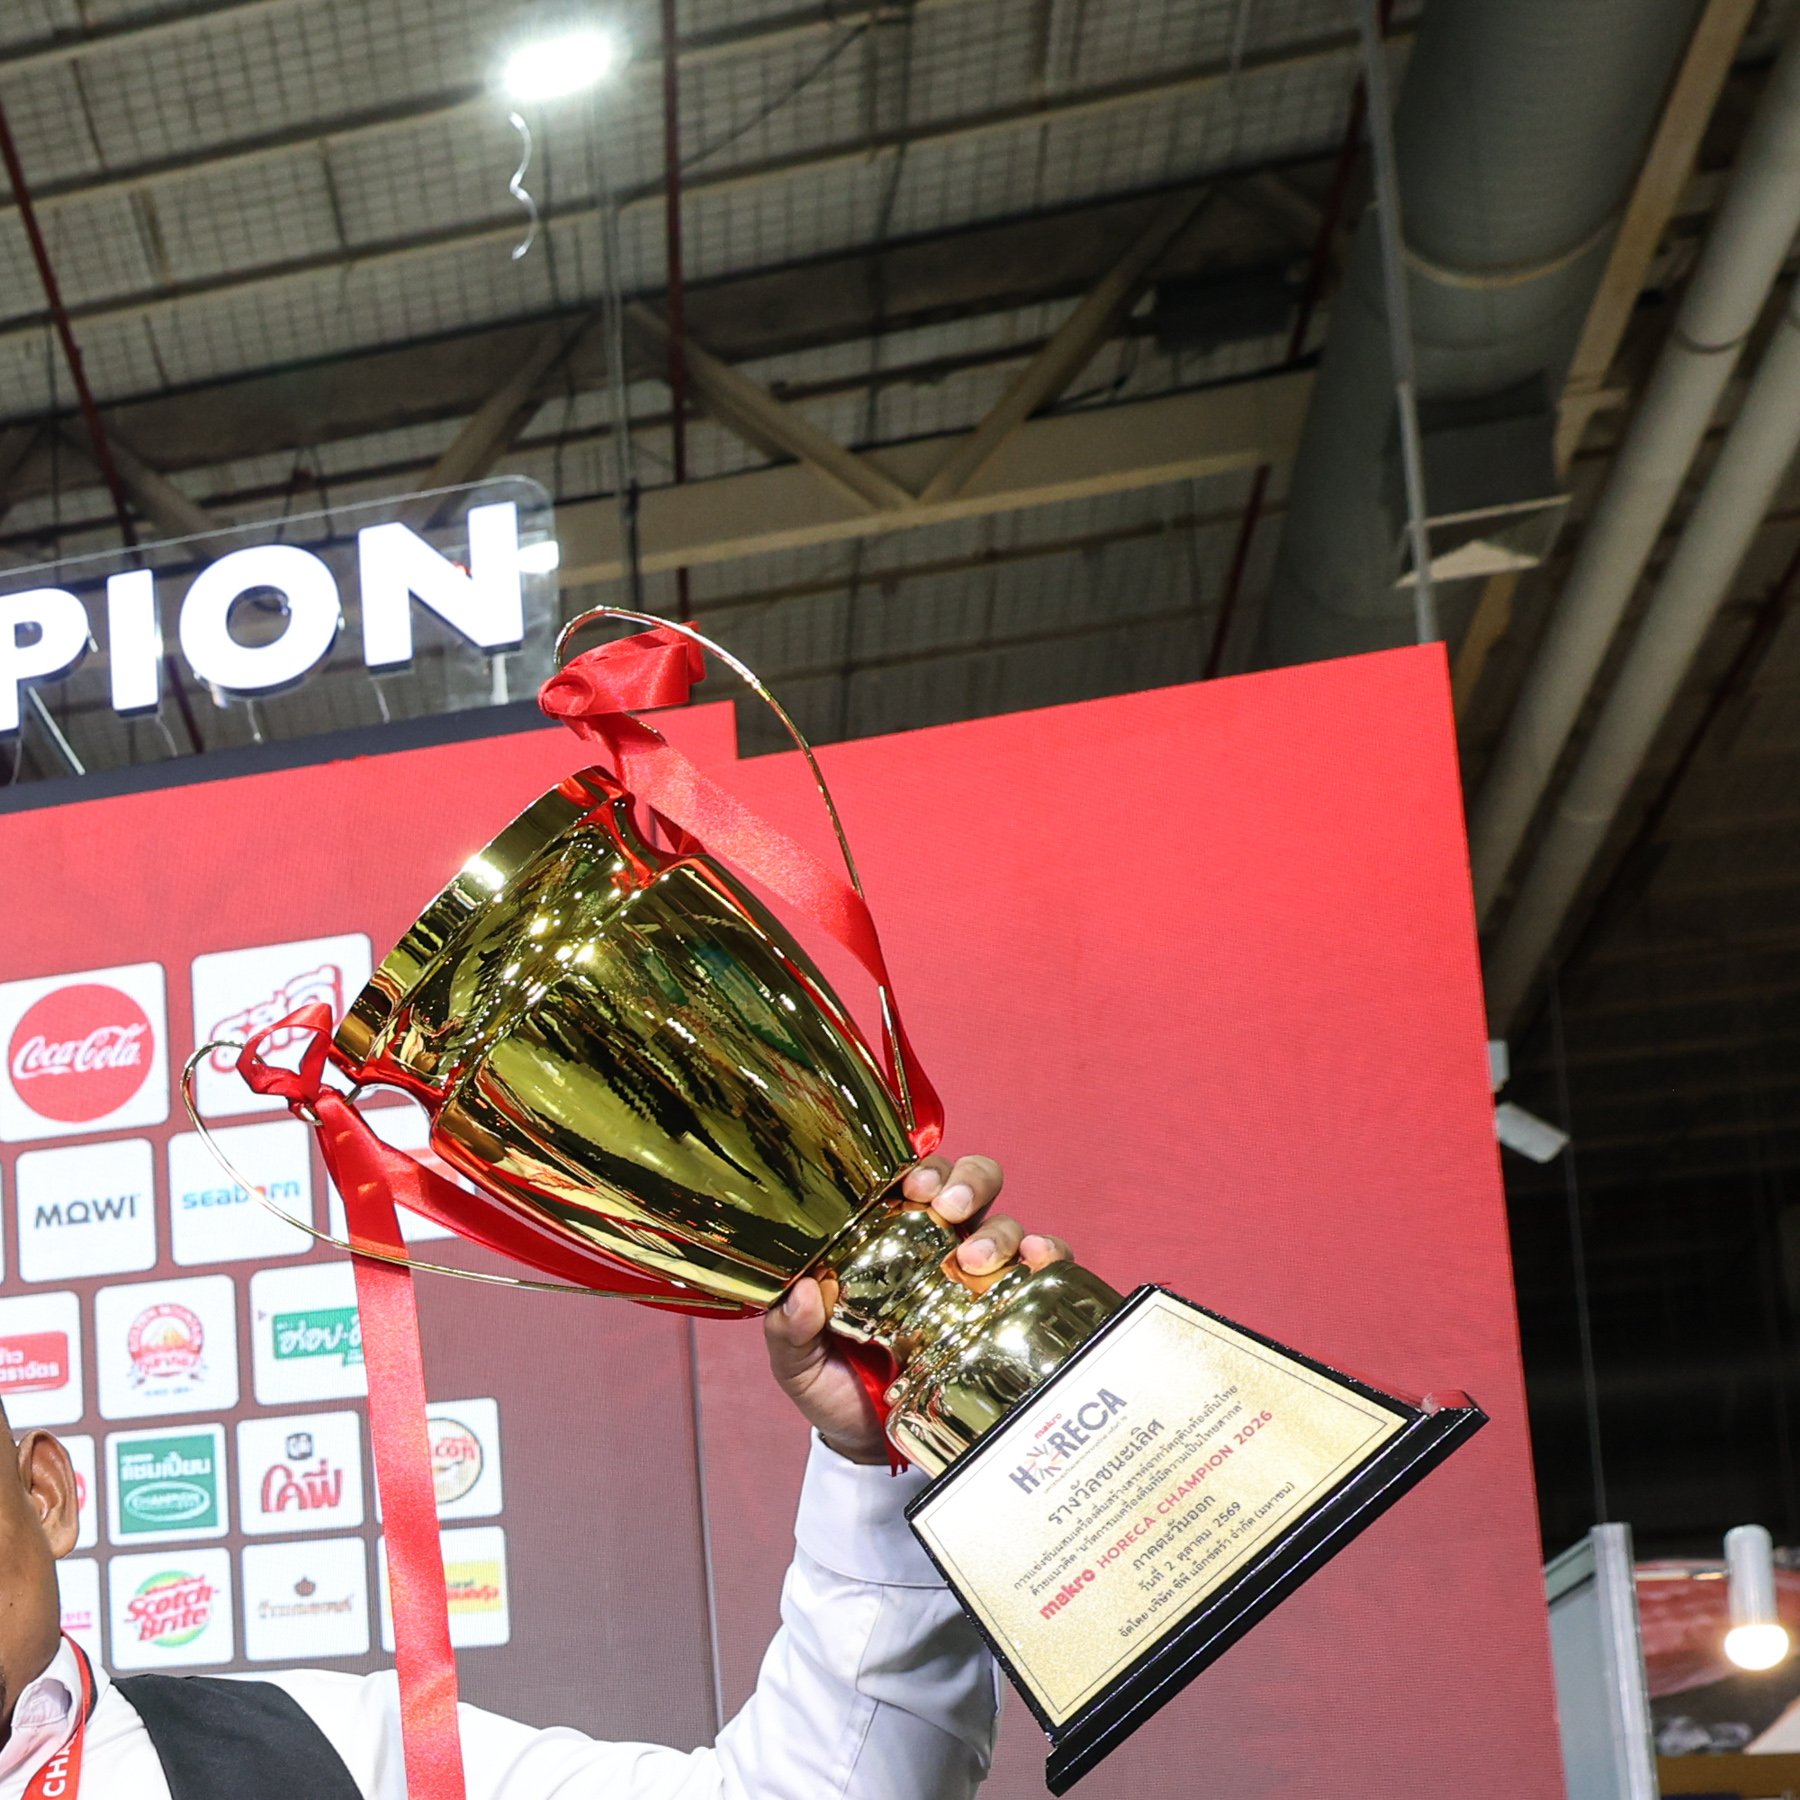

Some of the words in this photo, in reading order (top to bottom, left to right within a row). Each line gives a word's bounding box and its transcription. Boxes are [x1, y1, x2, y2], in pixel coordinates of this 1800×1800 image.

[13, 1023, 148, 1080] Coca-Cola
[35, 1197, 137, 1229] MOWI
[1008, 1388, 1127, 1494] HORECA
[1048, 1418, 1165, 1525] รางวัลชนะเลิศ
[1039, 1568, 1096, 1620] makro
[1097, 1515, 1156, 1569] HORECA
[1156, 1444, 1234, 1515] CHAMPION
[1233, 1409, 1273, 1444] 2026
[1131, 1494, 1214, 1570] ภาคตะวันออก
